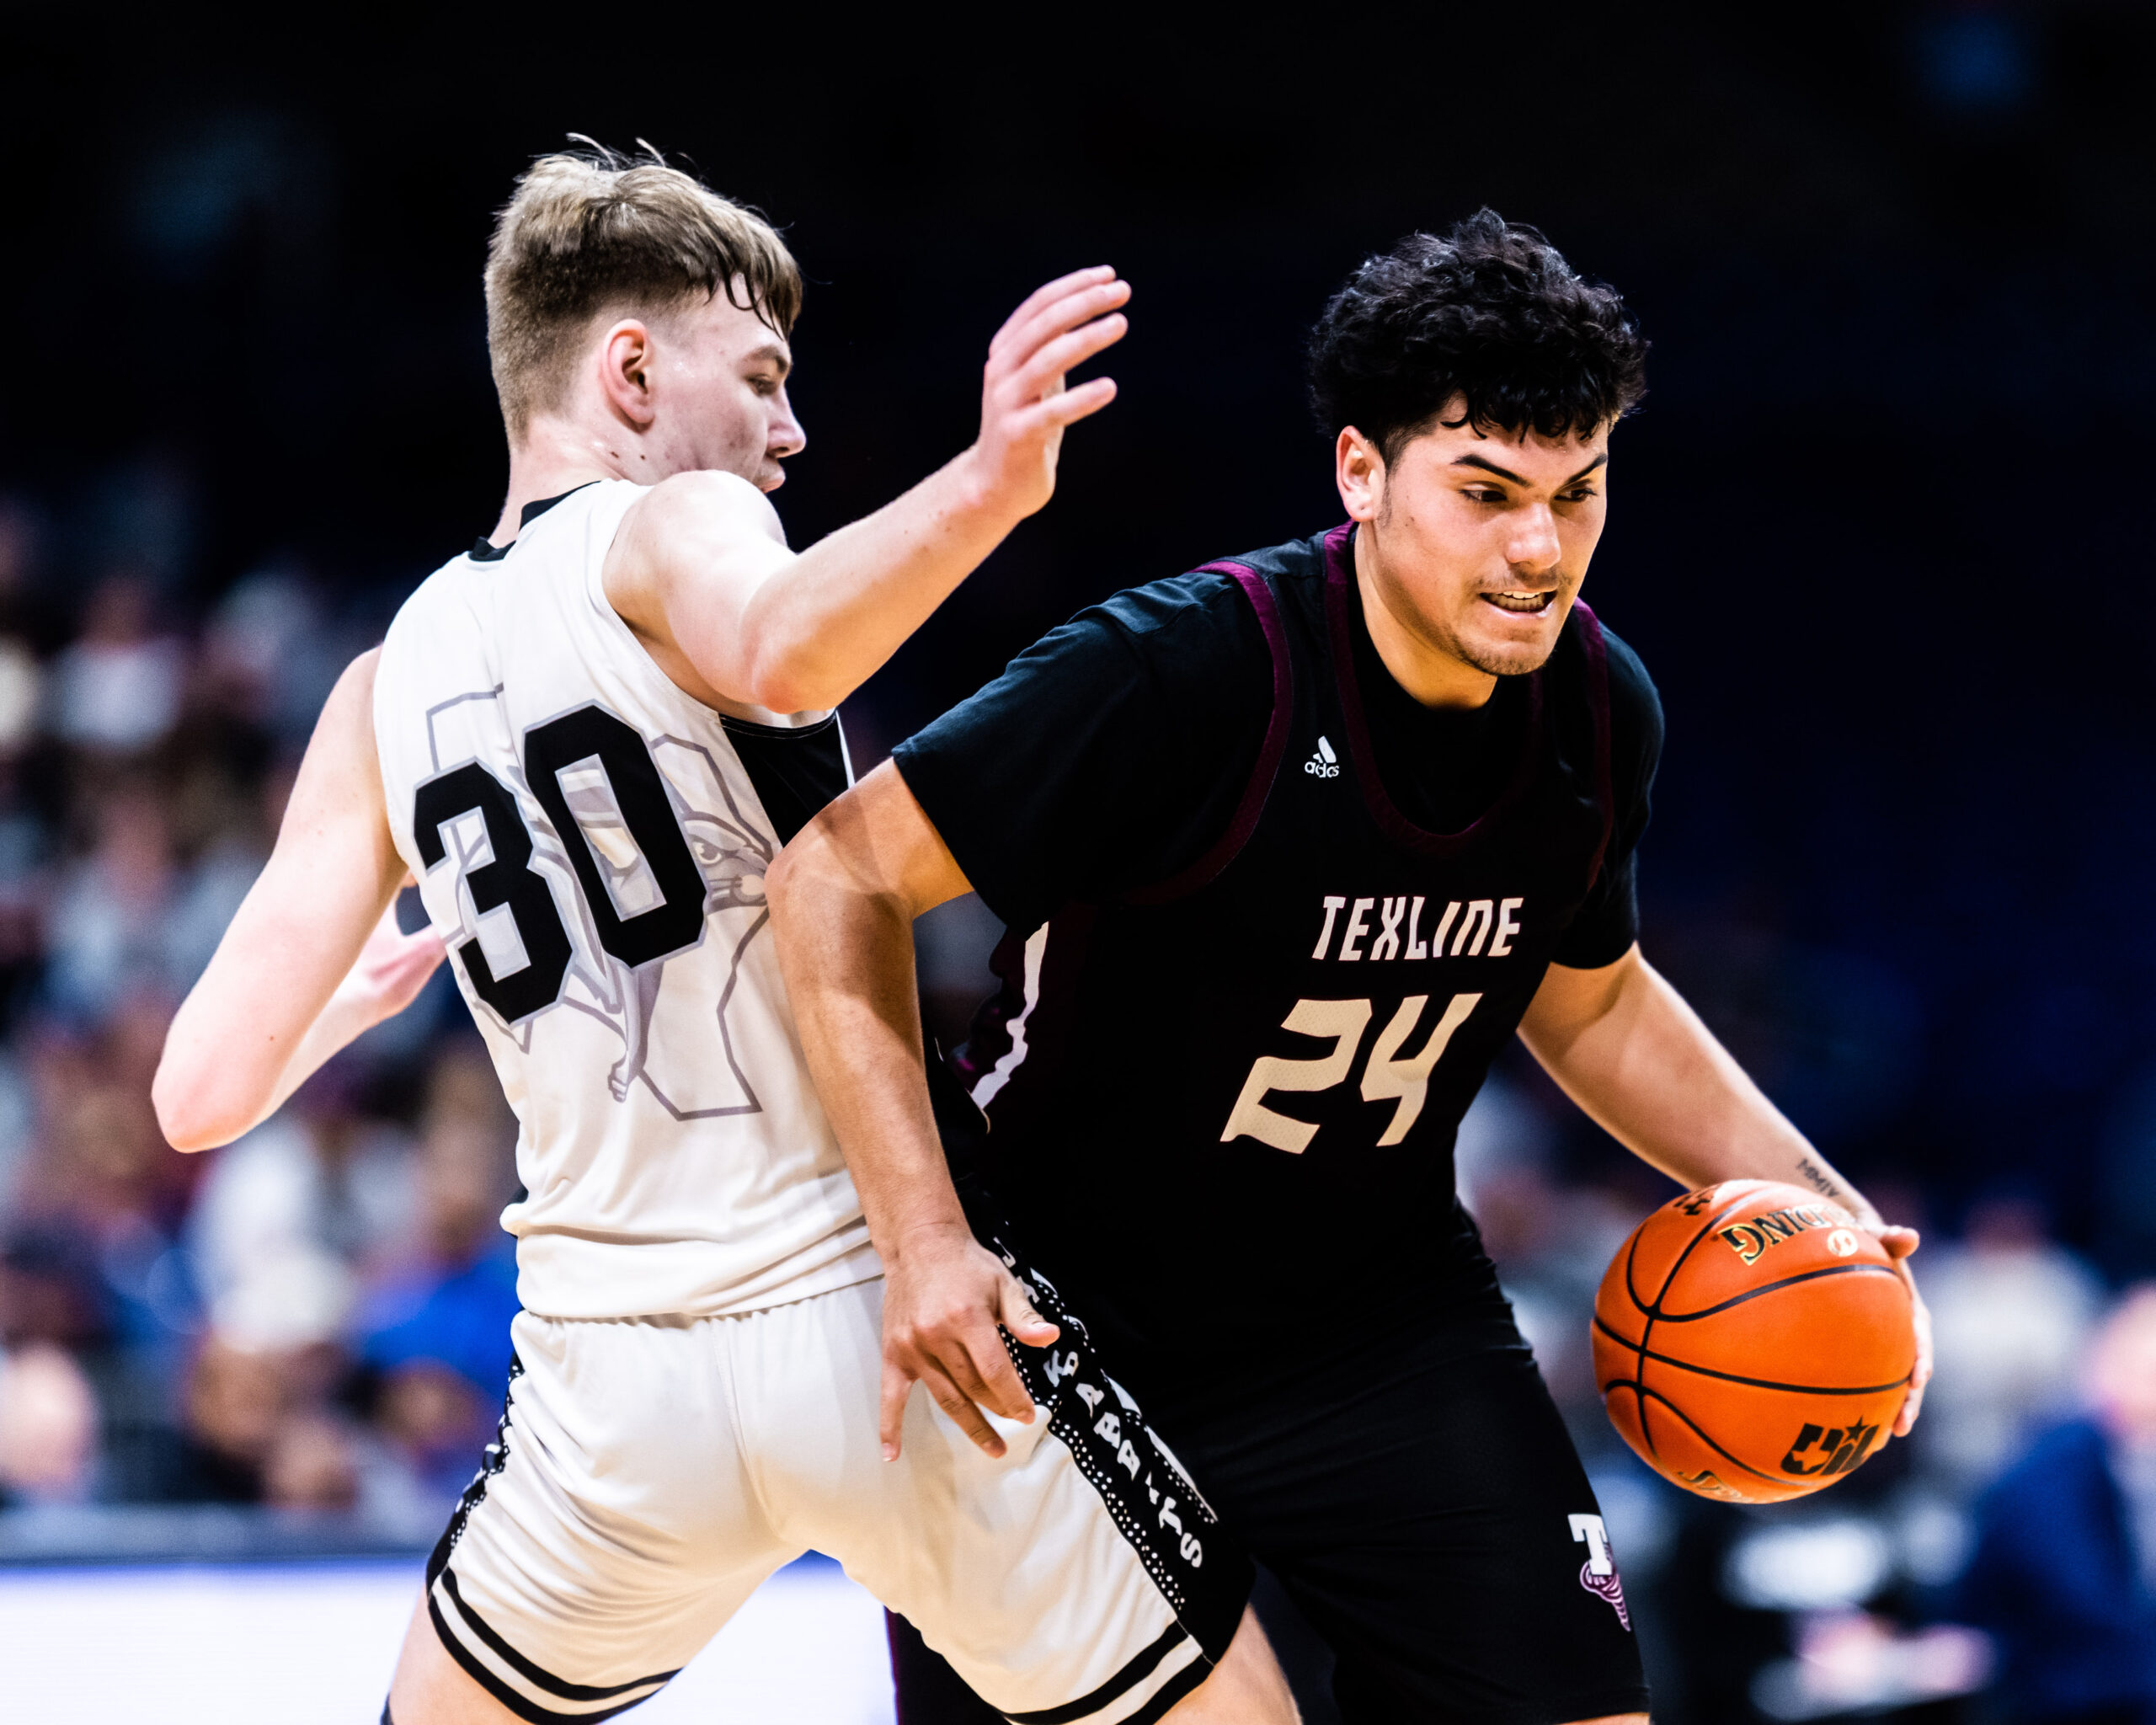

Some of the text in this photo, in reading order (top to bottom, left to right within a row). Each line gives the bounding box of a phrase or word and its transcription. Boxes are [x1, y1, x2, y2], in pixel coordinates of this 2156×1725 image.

[412, 701, 707, 1027] 30
[1311, 896, 1524, 961] TEXLINE
[1219, 992, 1483, 1155] 24
